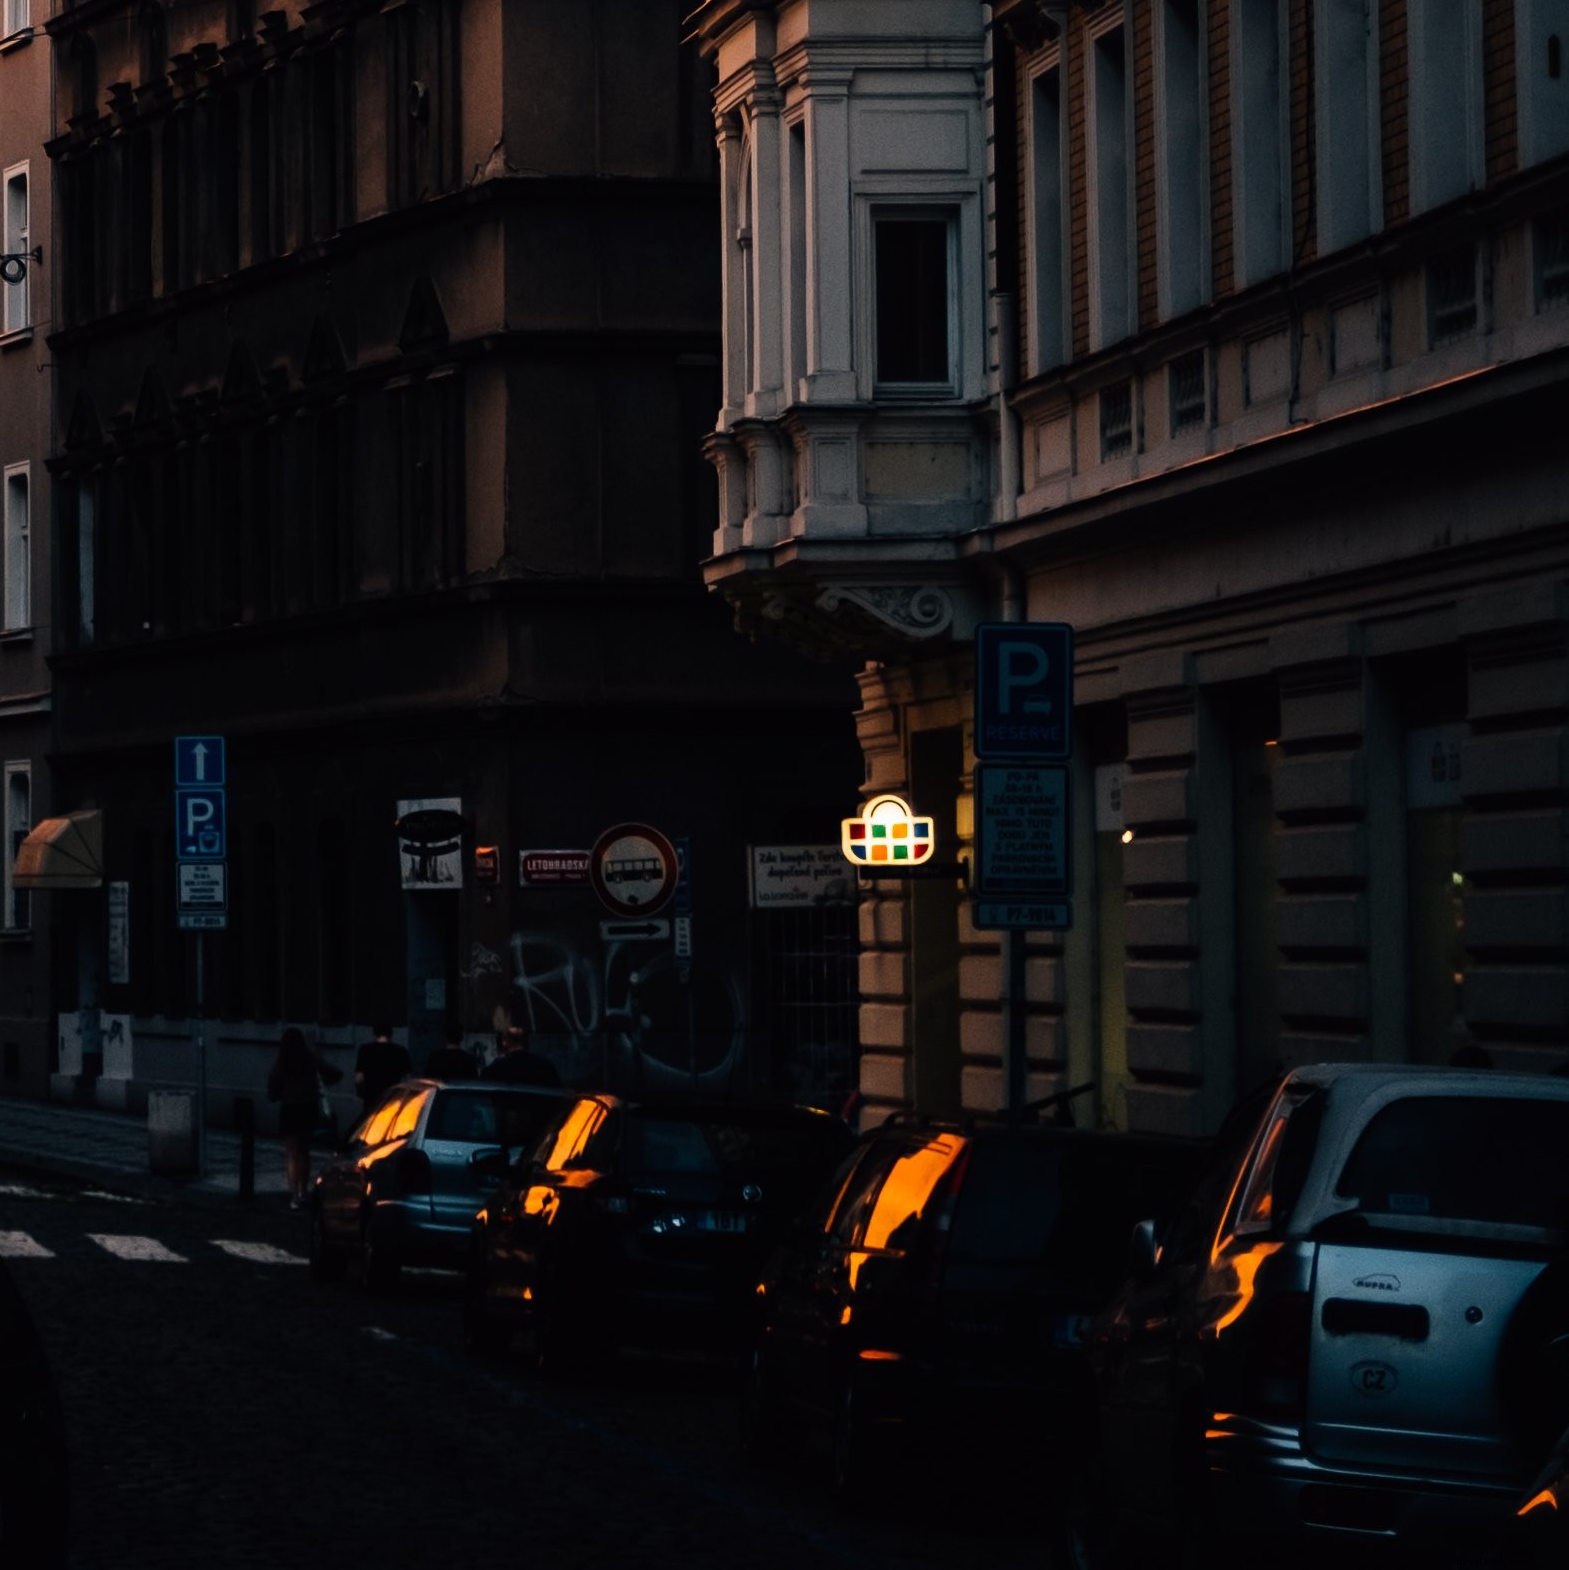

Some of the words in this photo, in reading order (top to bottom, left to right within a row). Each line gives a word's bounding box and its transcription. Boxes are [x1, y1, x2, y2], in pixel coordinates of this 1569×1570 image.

[998, 641, 1050, 716] P
[986, 722, 1062, 742] RÉSERVÉ
[187, 798, 214, 837] P
[1362, 1369, 1386, 1390] CZ
